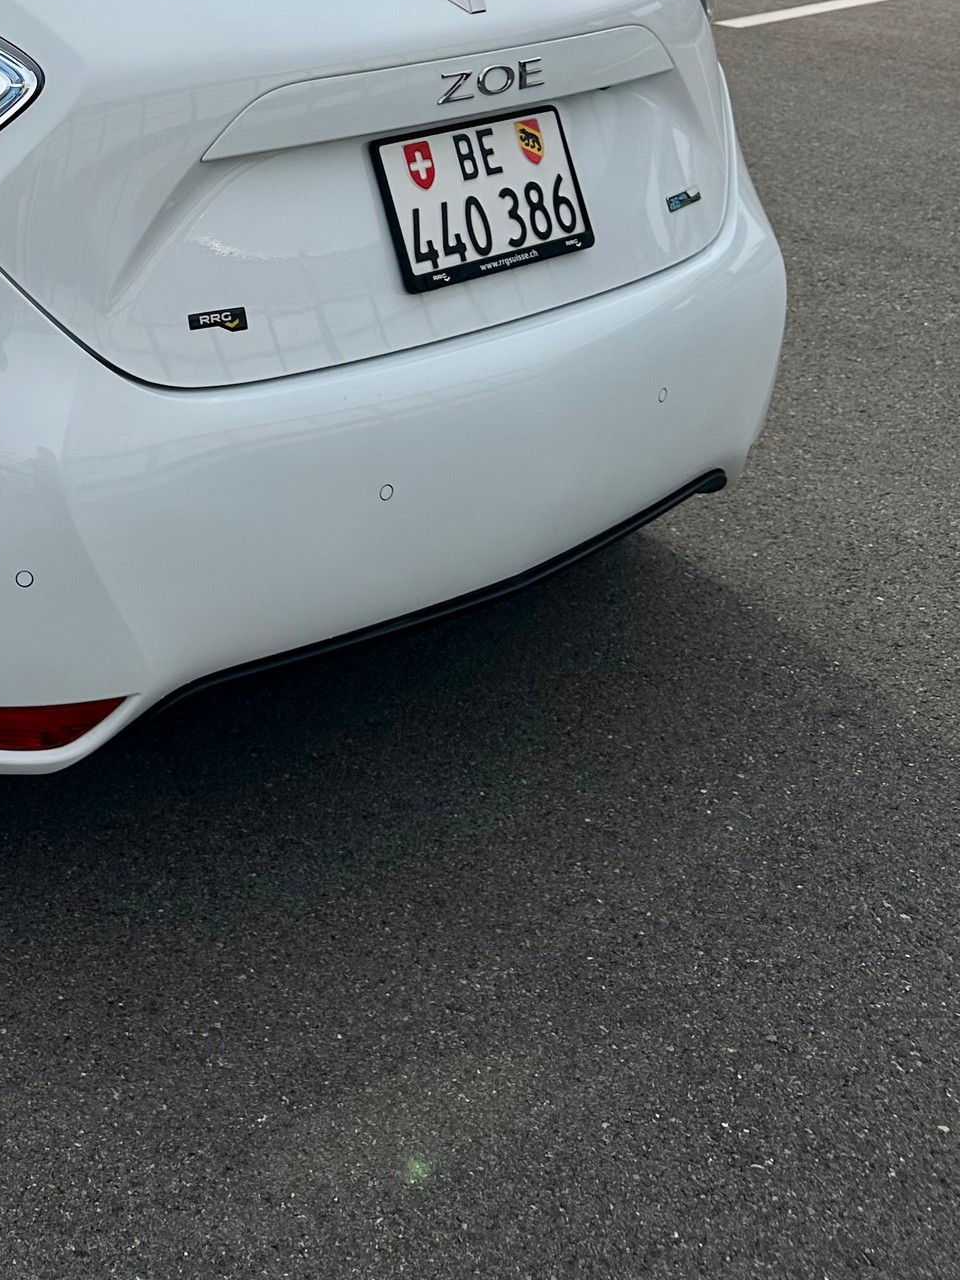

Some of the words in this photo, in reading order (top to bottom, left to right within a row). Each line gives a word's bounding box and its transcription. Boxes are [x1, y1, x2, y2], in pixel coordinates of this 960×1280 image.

[437, 56, 545, 105] ZOE
[452, 128, 503, 181] BE
[412, 196, 492, 269] 440
[498, 173, 576, 248] 386
[480, 249, 539, 270] www.rrgsuisse.ch
[199, 312, 232, 325] RRG
